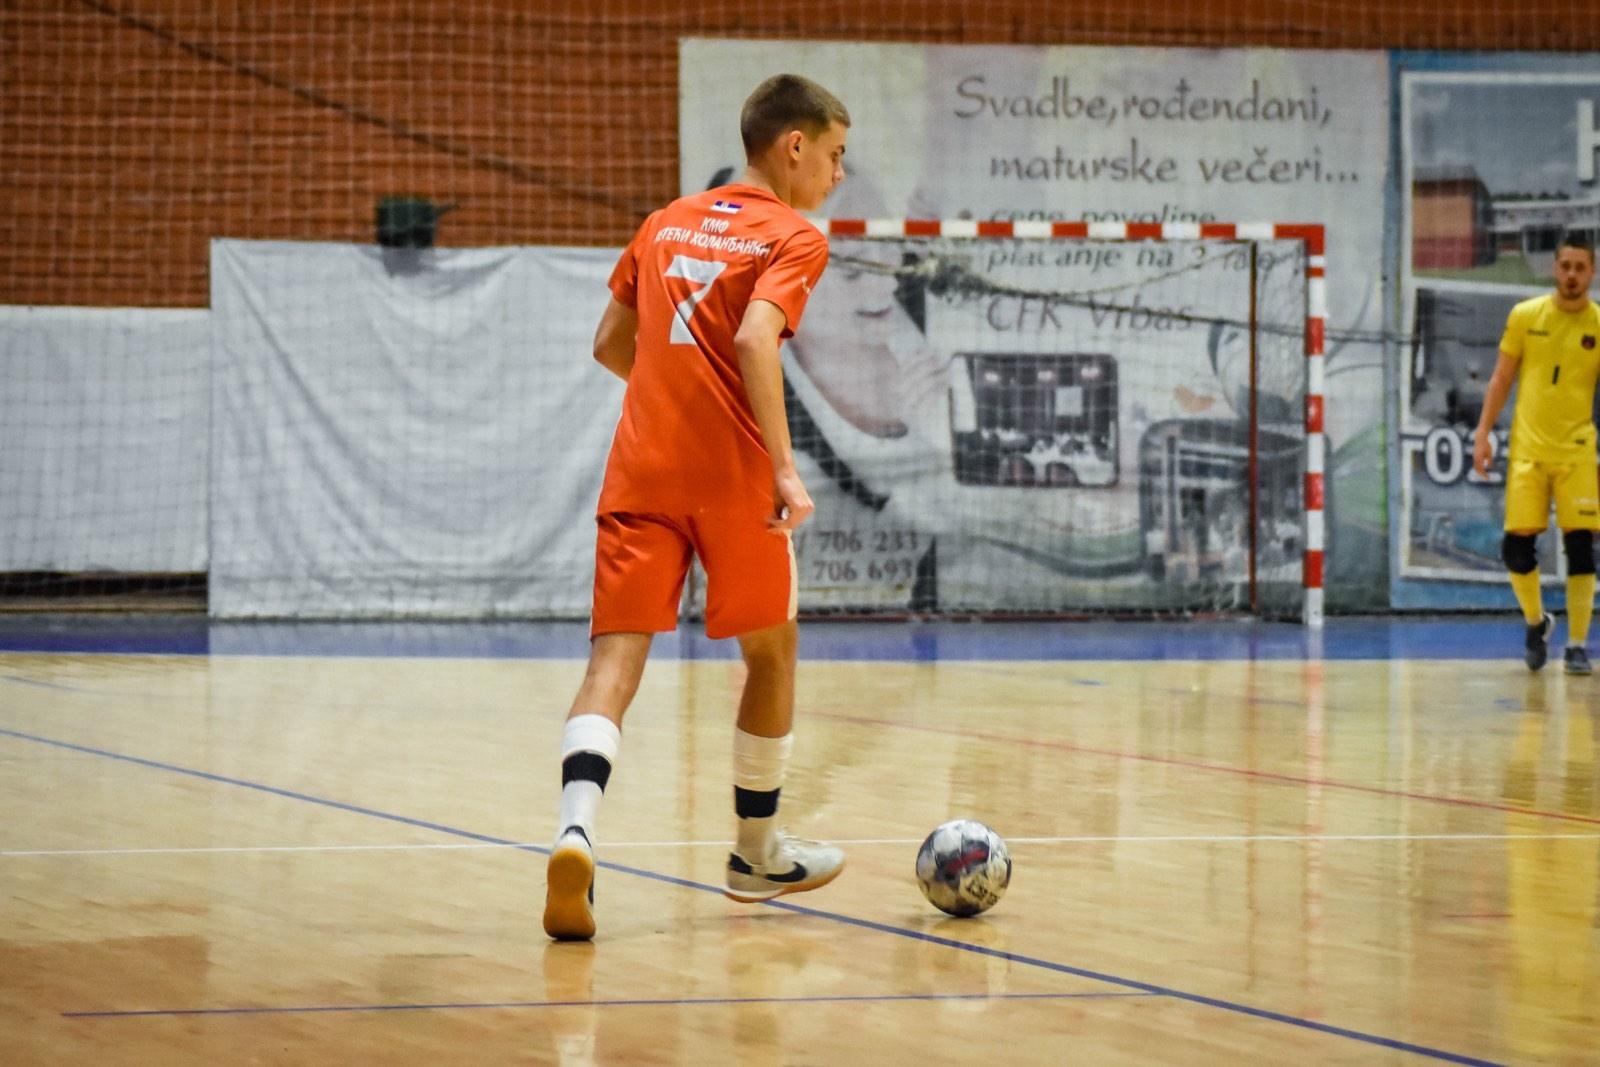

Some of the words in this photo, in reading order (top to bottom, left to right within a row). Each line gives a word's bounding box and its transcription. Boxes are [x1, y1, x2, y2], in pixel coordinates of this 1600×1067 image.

[989, 137, 1178, 184] maturske
[1200, 146, 1359, 184] večeri...
[701, 216, 730, 235] КМФ
[1137, 248, 1174, 267] na
[664, 254, 728, 344] 7
[1088, 290, 1194, 332] Vrbas
[817, 528, 862, 552] 706
[813, 560, 858, 582] 706
